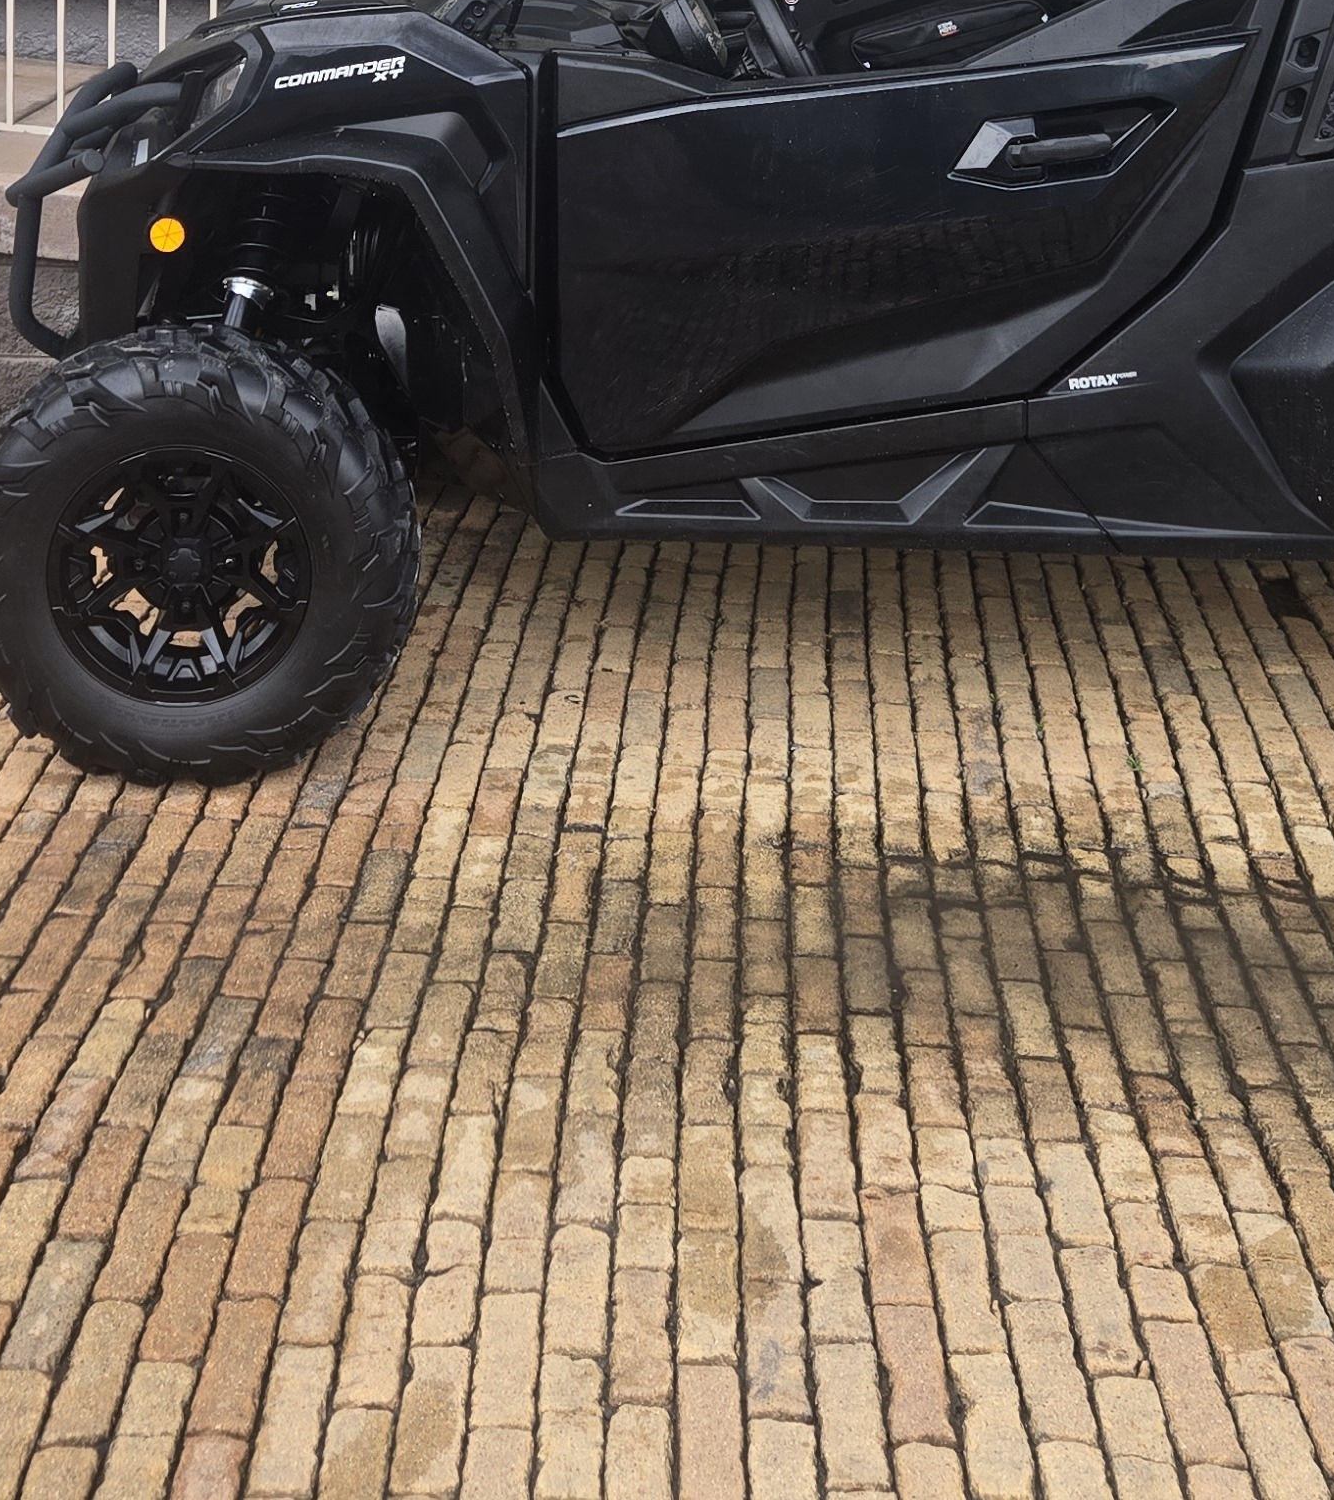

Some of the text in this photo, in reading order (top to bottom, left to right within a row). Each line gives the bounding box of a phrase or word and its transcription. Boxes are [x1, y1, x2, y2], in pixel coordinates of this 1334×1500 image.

[274, 56, 406, 90] COMMANDER
[372, 68, 405, 83] XT
[1068, 373, 1118, 390] ROTAX
